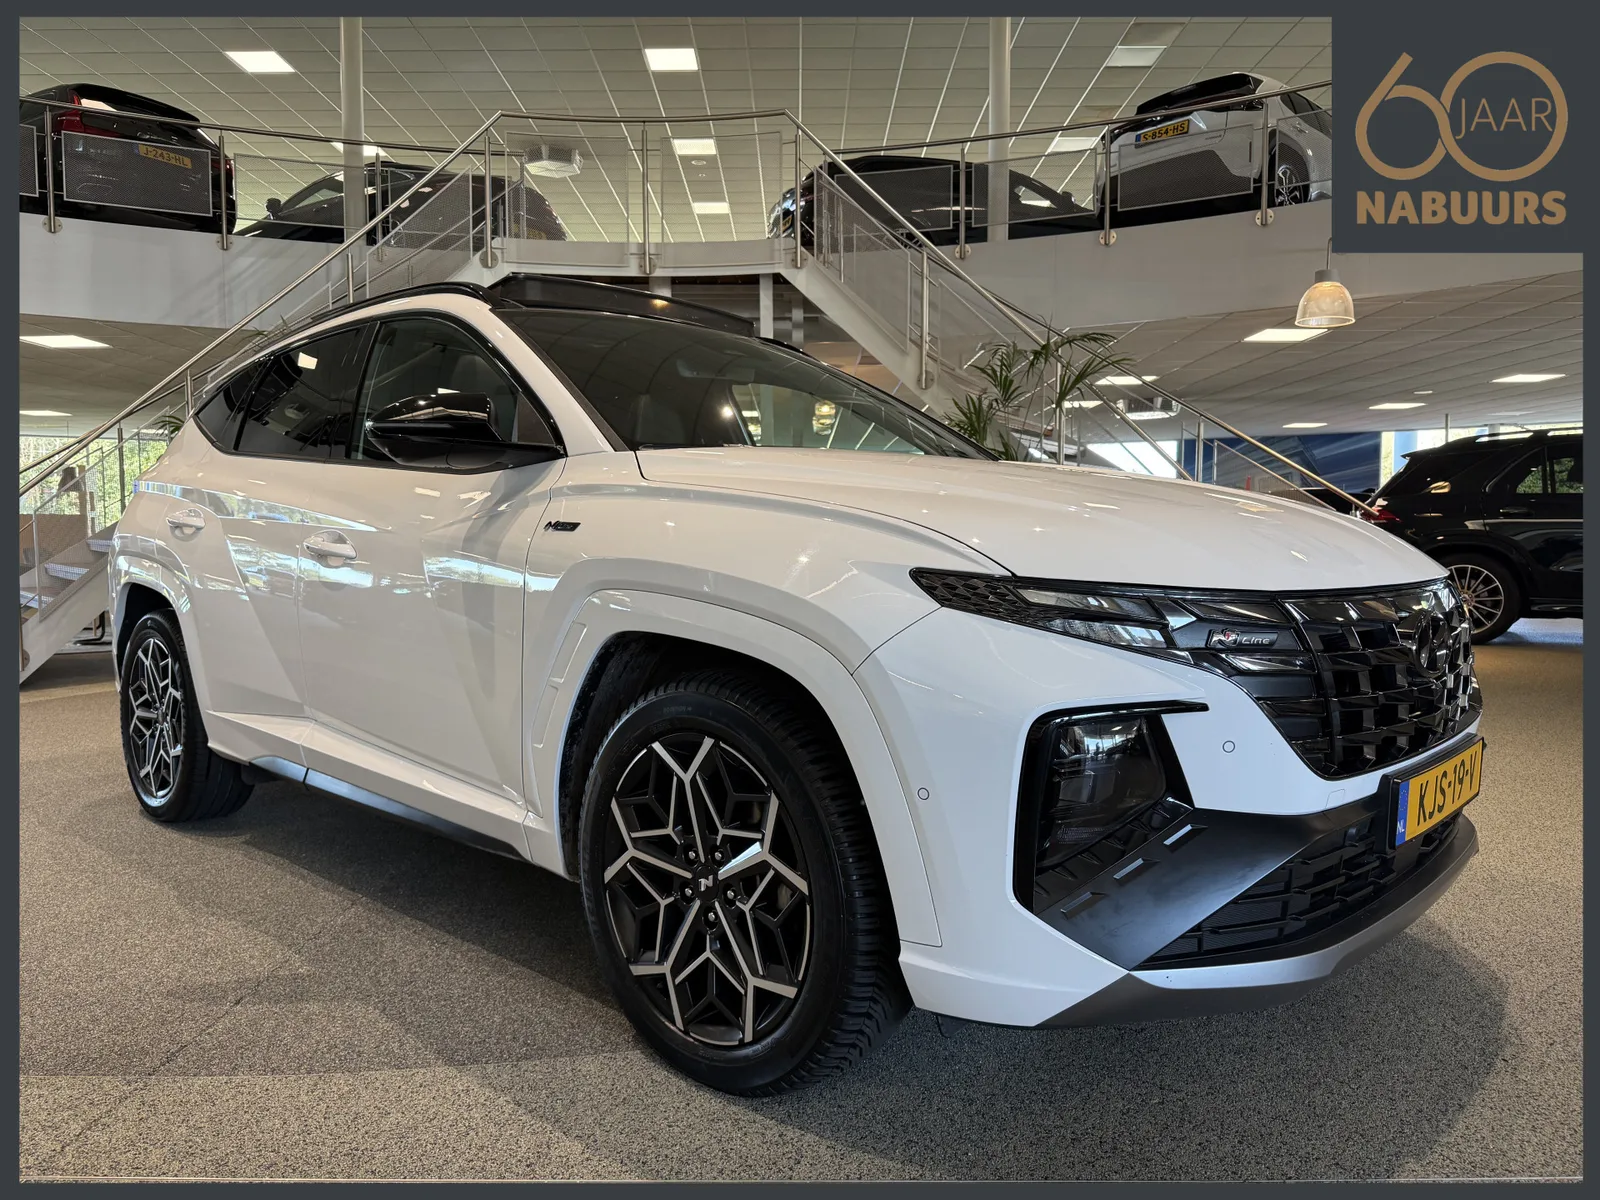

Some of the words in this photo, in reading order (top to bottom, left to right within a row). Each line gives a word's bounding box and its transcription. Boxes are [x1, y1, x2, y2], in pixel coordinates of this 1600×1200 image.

[1142, 122, 1185, 141] S-854-HS
[143, 147, 188, 167] J-243-HL
[1417, 750, 1477, 827] KJS-19-V
[1396, 819, 1405, 835] NL
